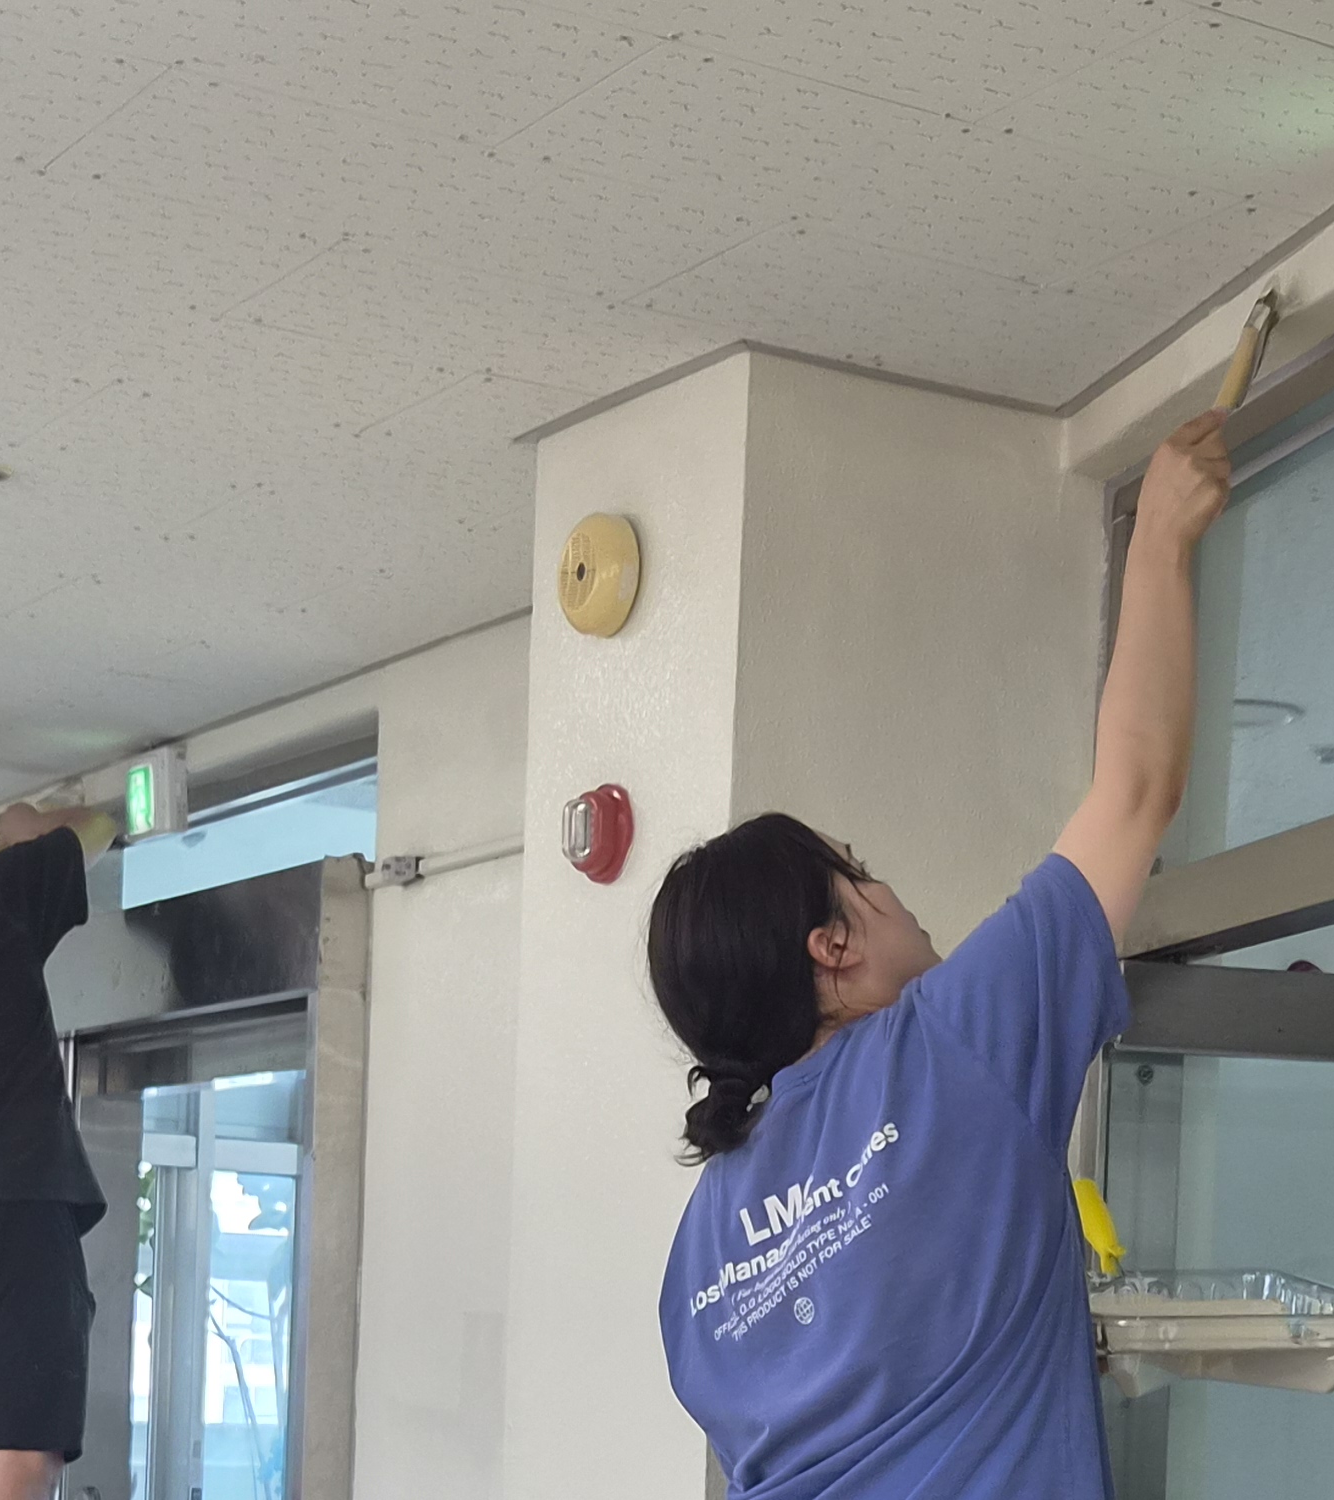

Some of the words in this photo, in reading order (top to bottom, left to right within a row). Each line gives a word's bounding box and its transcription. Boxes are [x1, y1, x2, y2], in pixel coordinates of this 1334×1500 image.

[806, 1228, 837, 1254] TYPE
[747, 1284, 787, 1328] PRODUCT
[786, 1276, 800, 1291] IS
[797, 1257, 819, 1283] NOT
[818, 1241, 843, 1264] FOR
